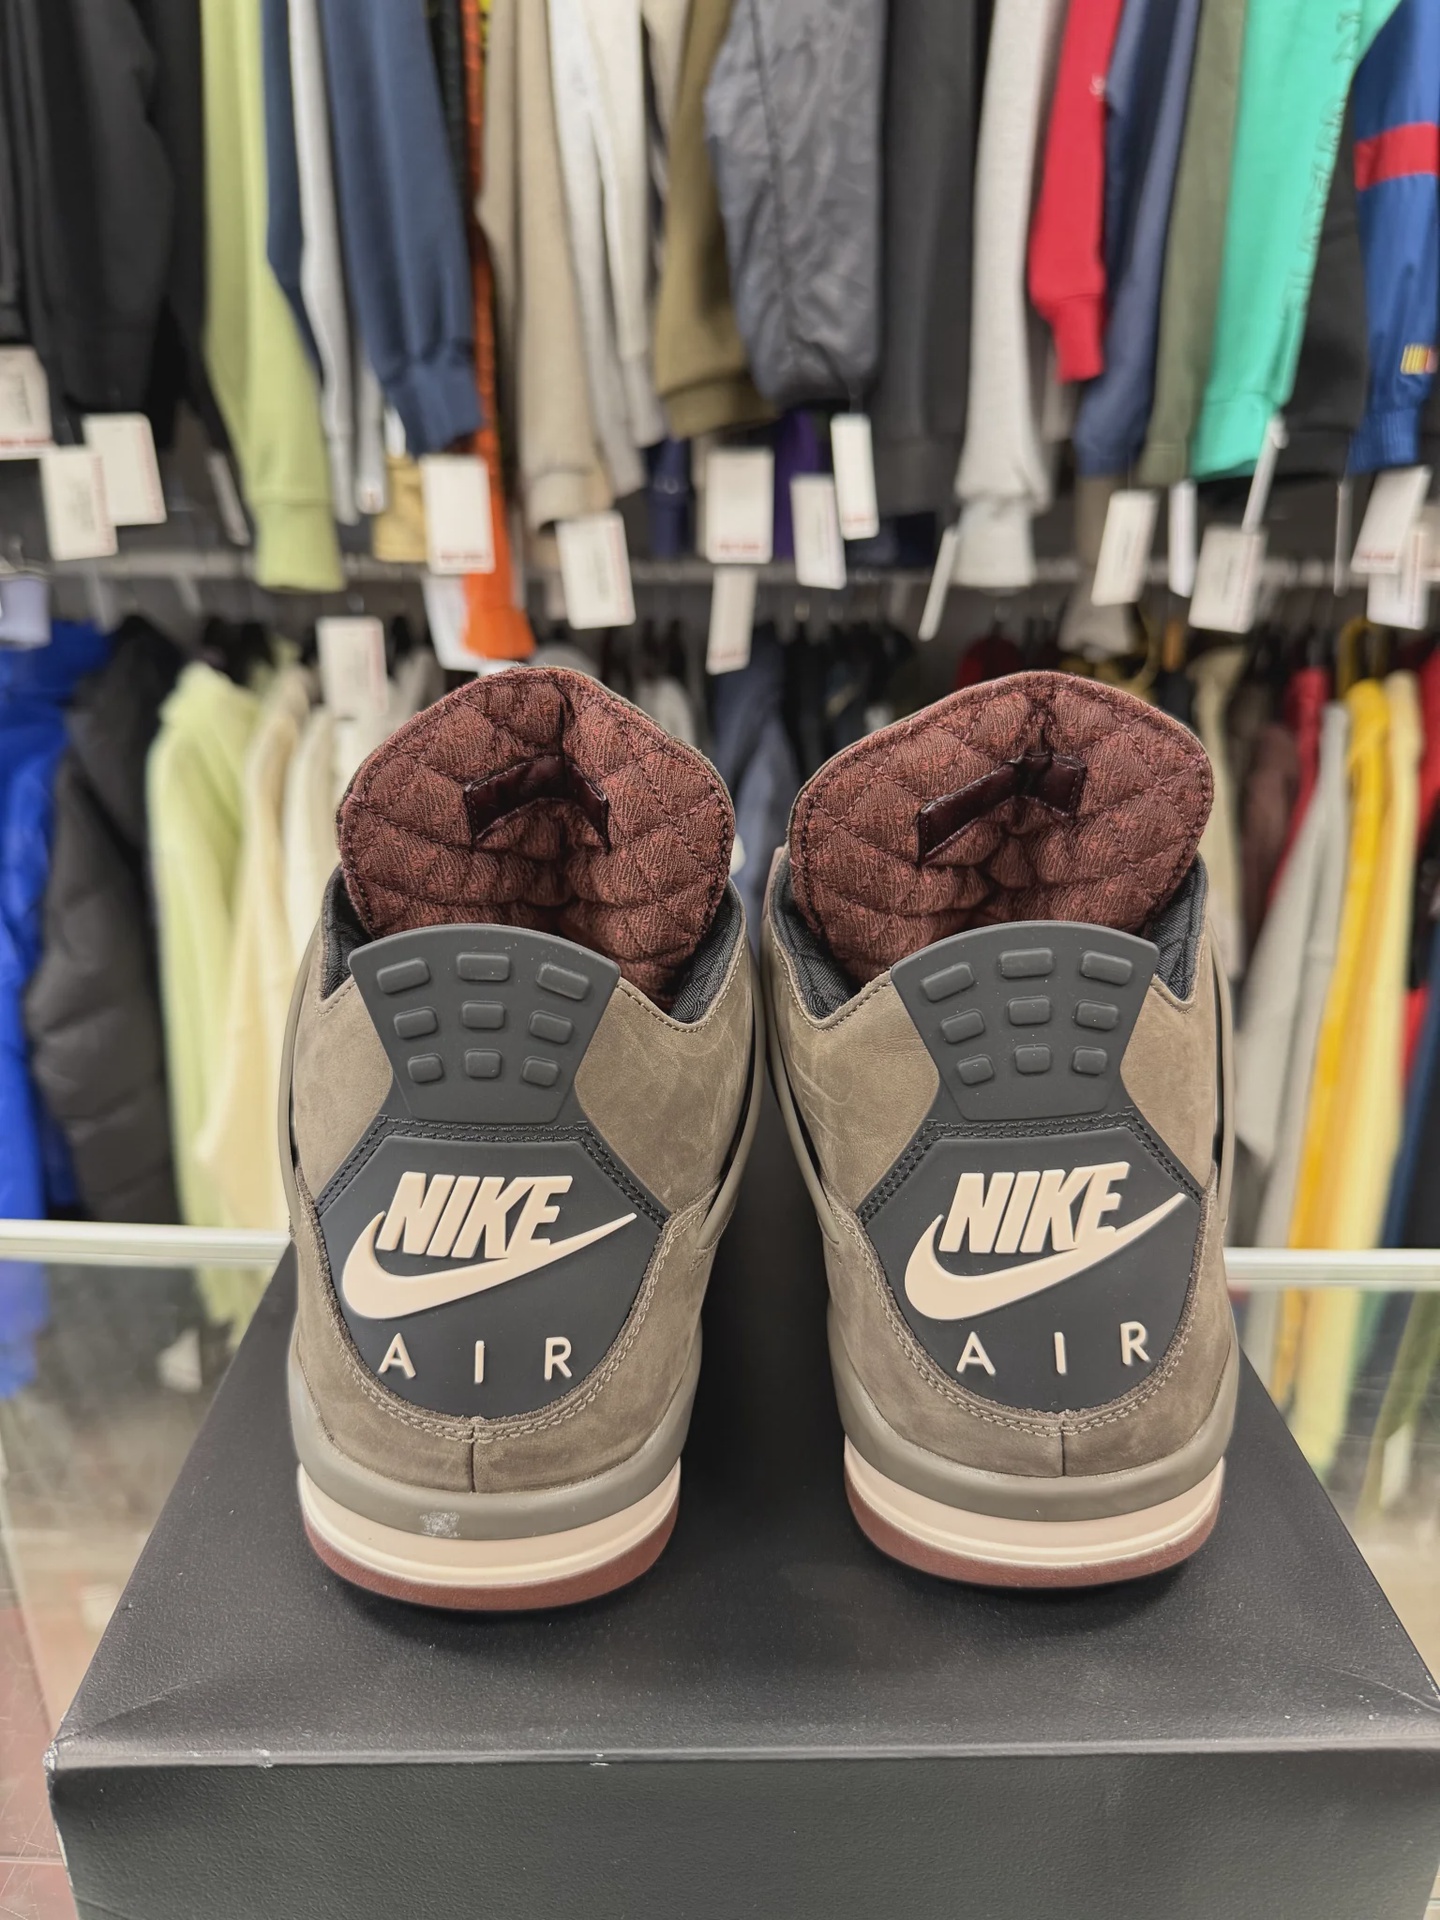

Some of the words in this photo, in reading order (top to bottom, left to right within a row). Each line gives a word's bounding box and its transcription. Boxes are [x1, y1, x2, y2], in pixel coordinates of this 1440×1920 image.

[376, 1171, 573, 1259] NIKE
[938, 1161, 1131, 1254] NIKE
[378, 1332, 573, 1385] AIR
[956, 1321, 1151, 1376] AIR
